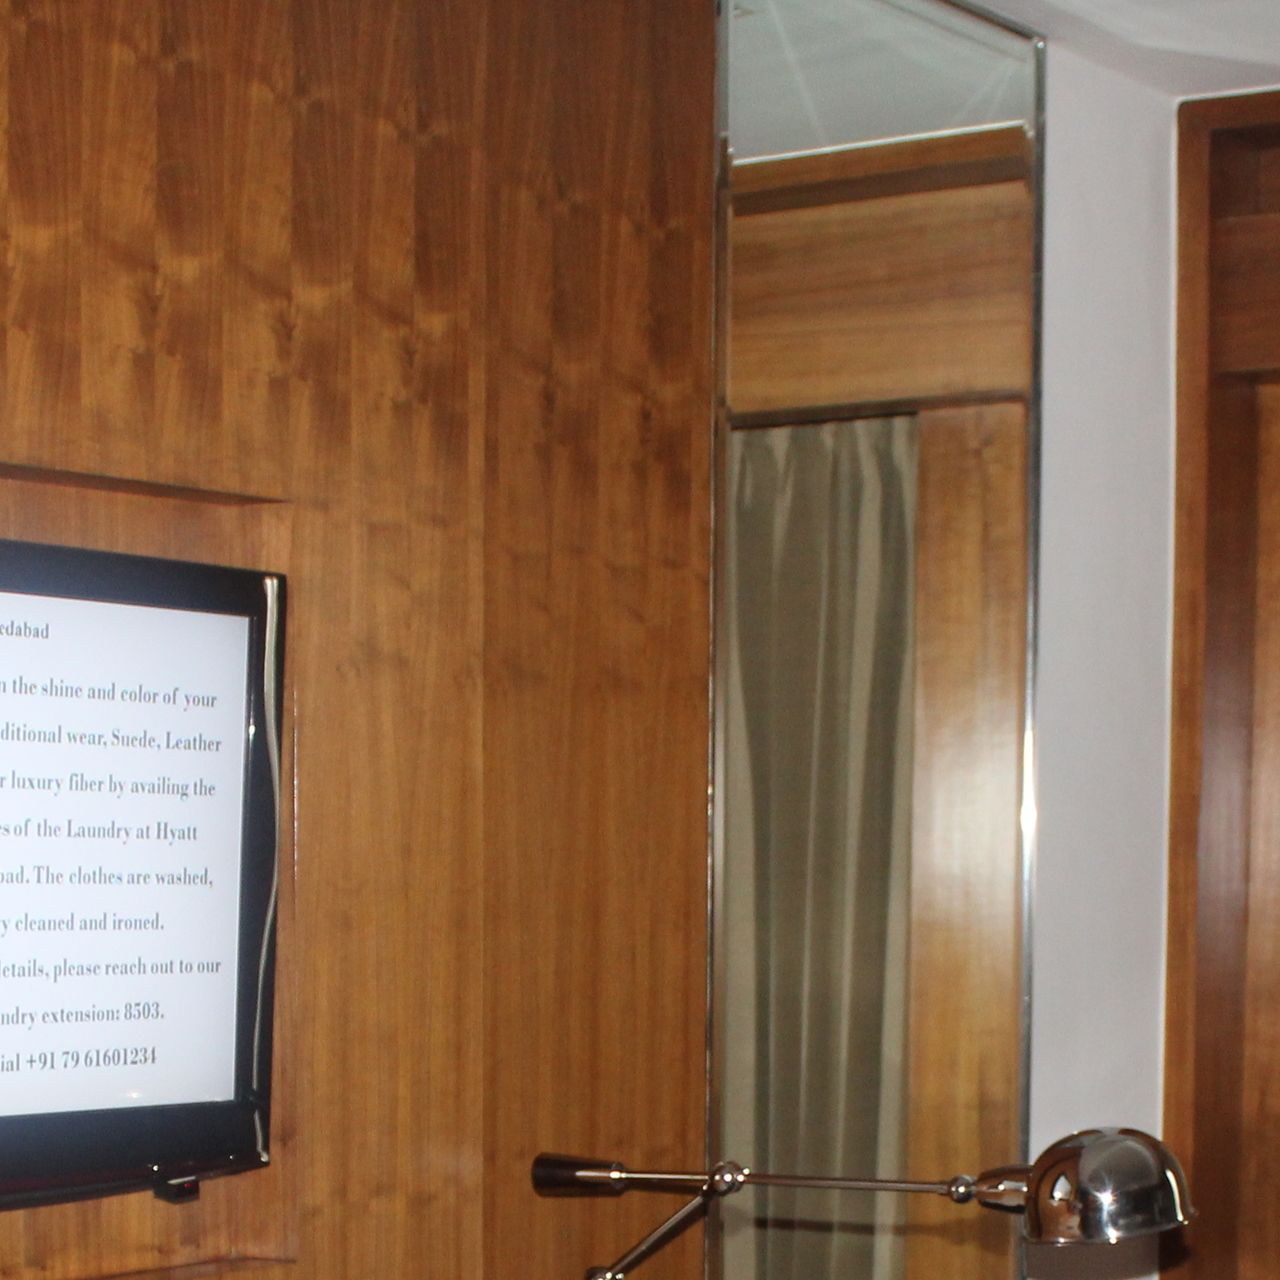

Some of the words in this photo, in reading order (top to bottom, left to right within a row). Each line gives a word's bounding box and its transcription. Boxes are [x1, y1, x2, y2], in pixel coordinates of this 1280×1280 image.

[12, 675, 38, 696] the
[41, 677, 83, 699] shine
[87, 682, 116, 701] and
[120, 684, 160, 704] color
[162, 686, 180, 706] of
[183, 693, 218, 713] your
[66, 731, 108, 749] wear,
[110, 728, 161, 751] Suede,
[165, 730, 223, 753] Leather
[11, 769, 63, 797] luxury
[68, 772, 105, 793] fiber
[108, 773, 126, 799] by
[130, 775, 190, 802] availing
[193, 777, 216, 797] the
[14, 817, 32, 837] of
[36, 818, 62, 838] the
[66, 818, 132, 846] Laundry
[135, 824, 151, 840] at
[156, 821, 197, 847] Hyatt
[33, 865, 64, 885] The
[68, 865, 123, 885] clothes
[126, 872, 151, 885] are
[154, 866, 213, 889] washed,
[14, 911, 75, 932] cleaned
[79, 911, 108, 931] and
[112, 911, 165, 931] ironed.
[53, 957, 101, 984] please
[104, 955, 147, 976] reach
[150, 959, 174, 975] out
[179, 959, 194, 974] to
[196, 961, 222, 974] our
[41, 1003, 121, 1024] extension:
[123, 1001, 165, 1021] 8503.
[26, 1051, 55, 1070] +91
[61, 1050, 81, 1069] 79
[83, 1046, 156, 1068] 61601234
